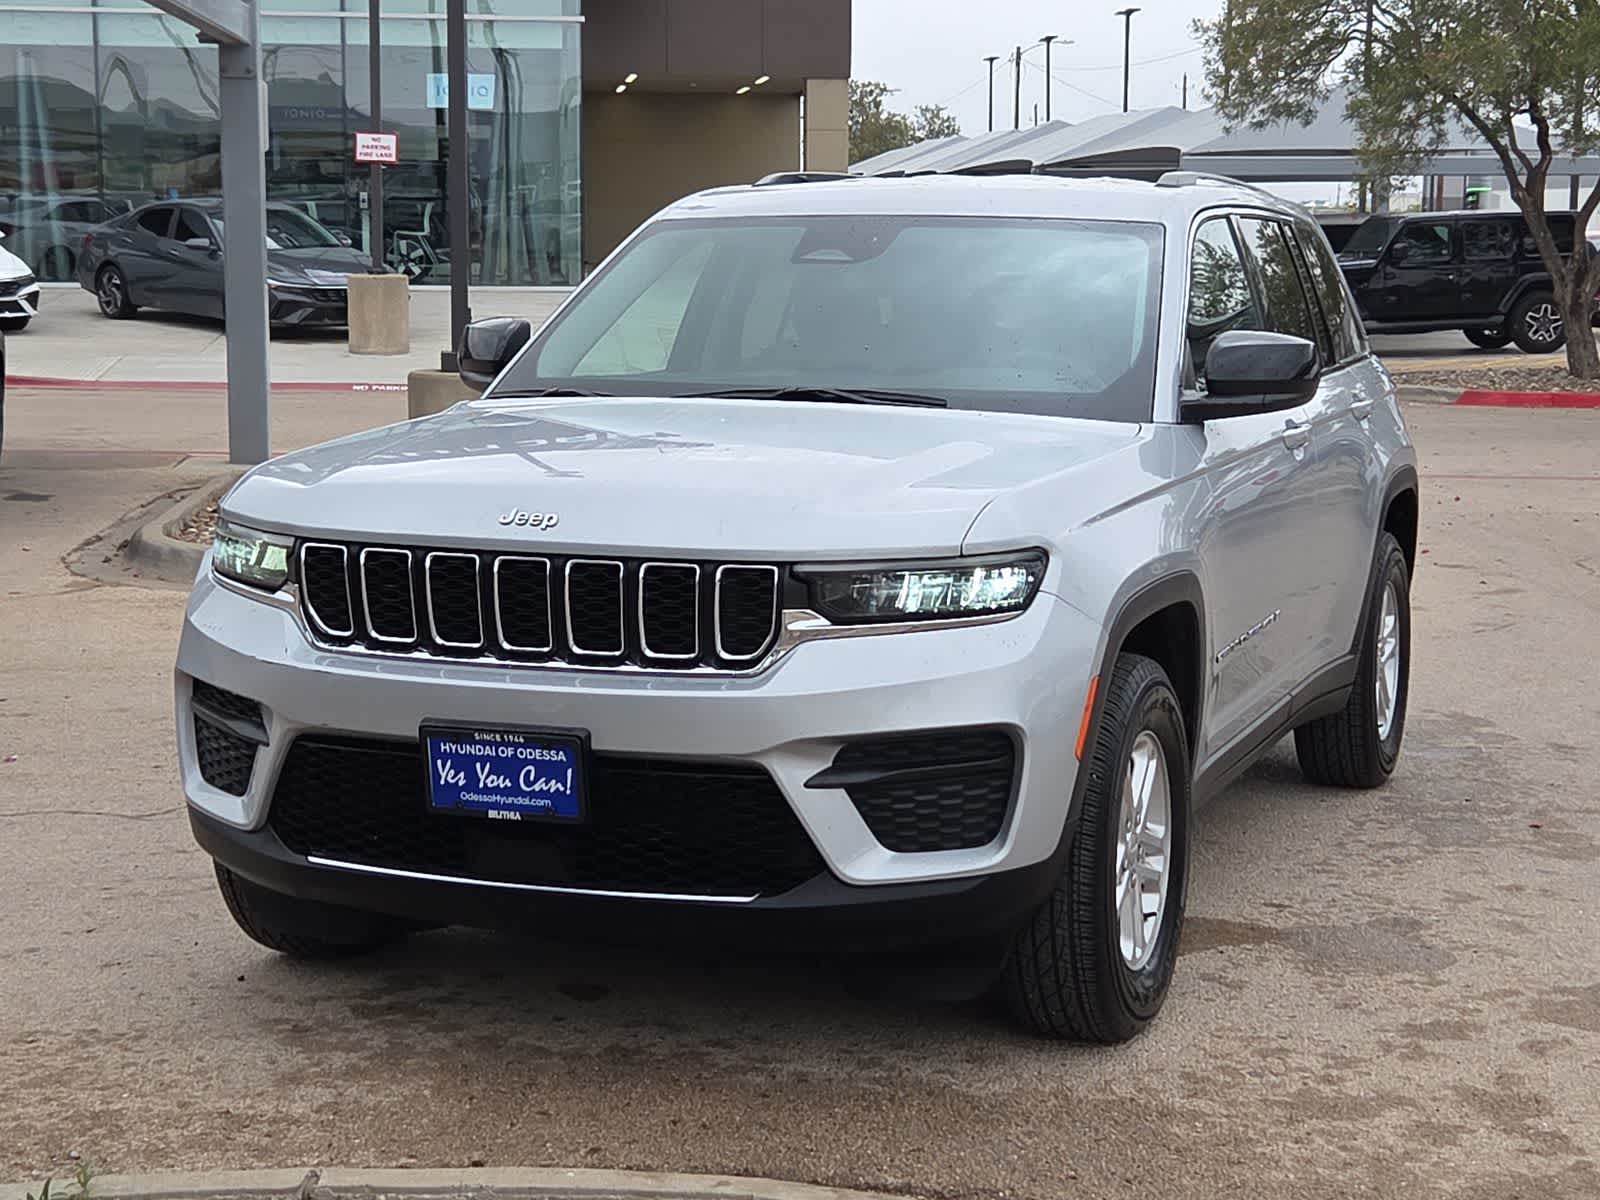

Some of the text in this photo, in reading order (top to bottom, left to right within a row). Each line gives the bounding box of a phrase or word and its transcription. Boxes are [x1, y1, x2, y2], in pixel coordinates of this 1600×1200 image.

[498, 507, 559, 531] Jeep
[474, 732, 501, 742] SINCE
[440, 742, 567, 762] HYUNDAI OF ODESSA
[437, 759, 573, 795] Yes You Can!
[460, 791, 551, 807] OdessaHyundai.com
